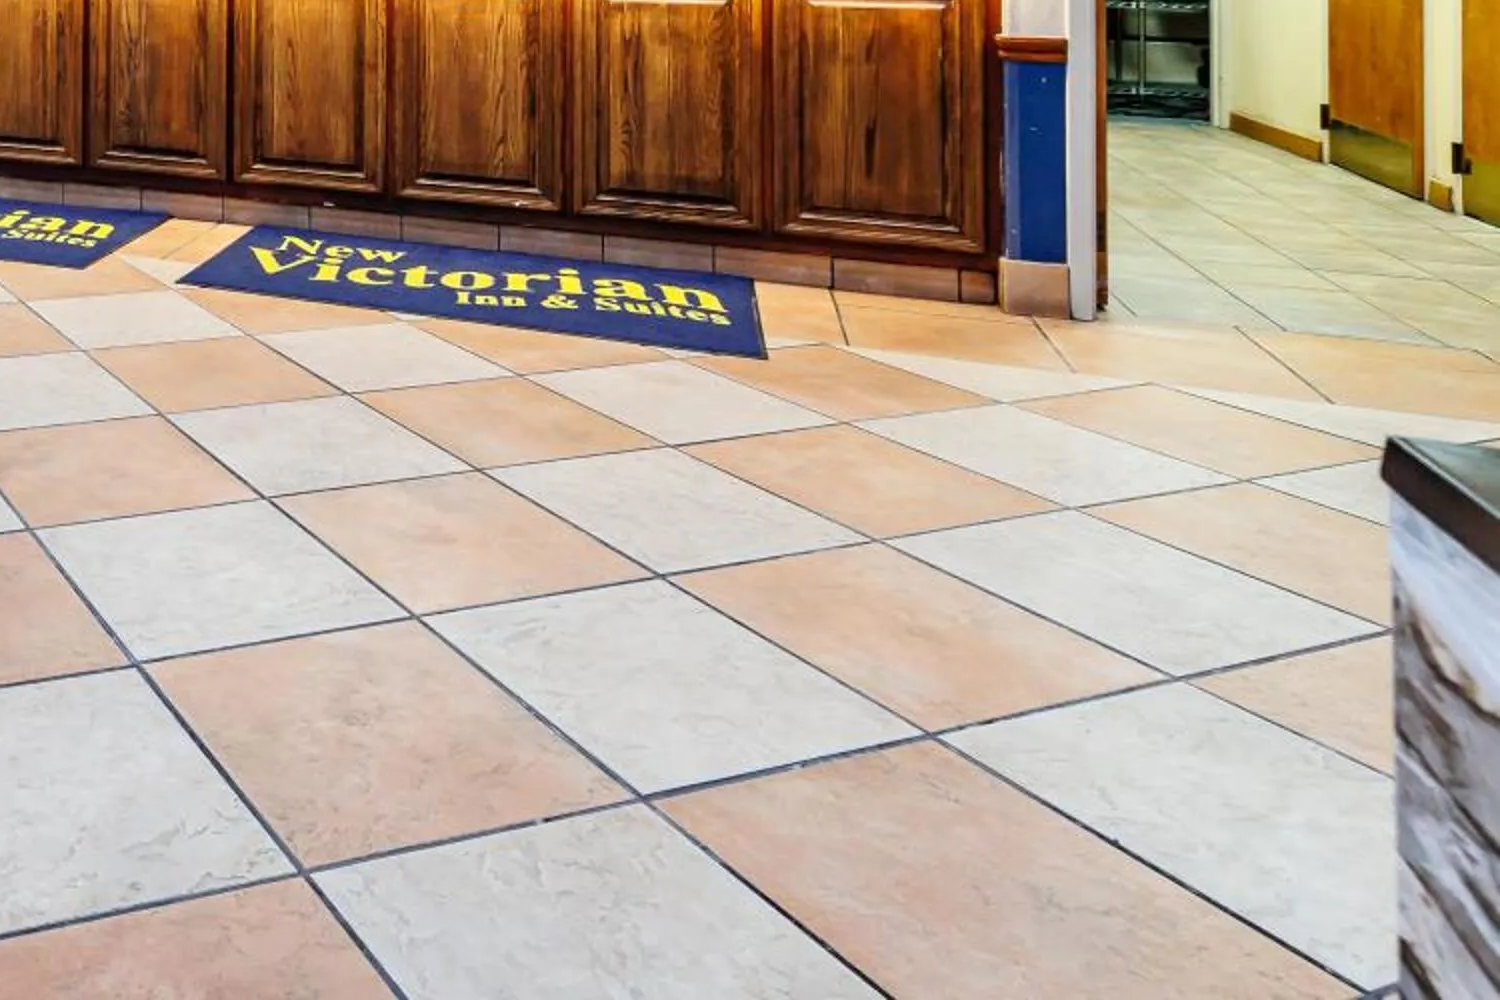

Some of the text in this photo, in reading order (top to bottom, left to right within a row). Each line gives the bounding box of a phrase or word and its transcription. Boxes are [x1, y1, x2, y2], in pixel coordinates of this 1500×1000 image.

[1, 229, 98, 248] Suites
[275, 235, 407, 263] New
[248, 246, 729, 313] Victorian
[456, 291, 732, 326] Inn & Suites
